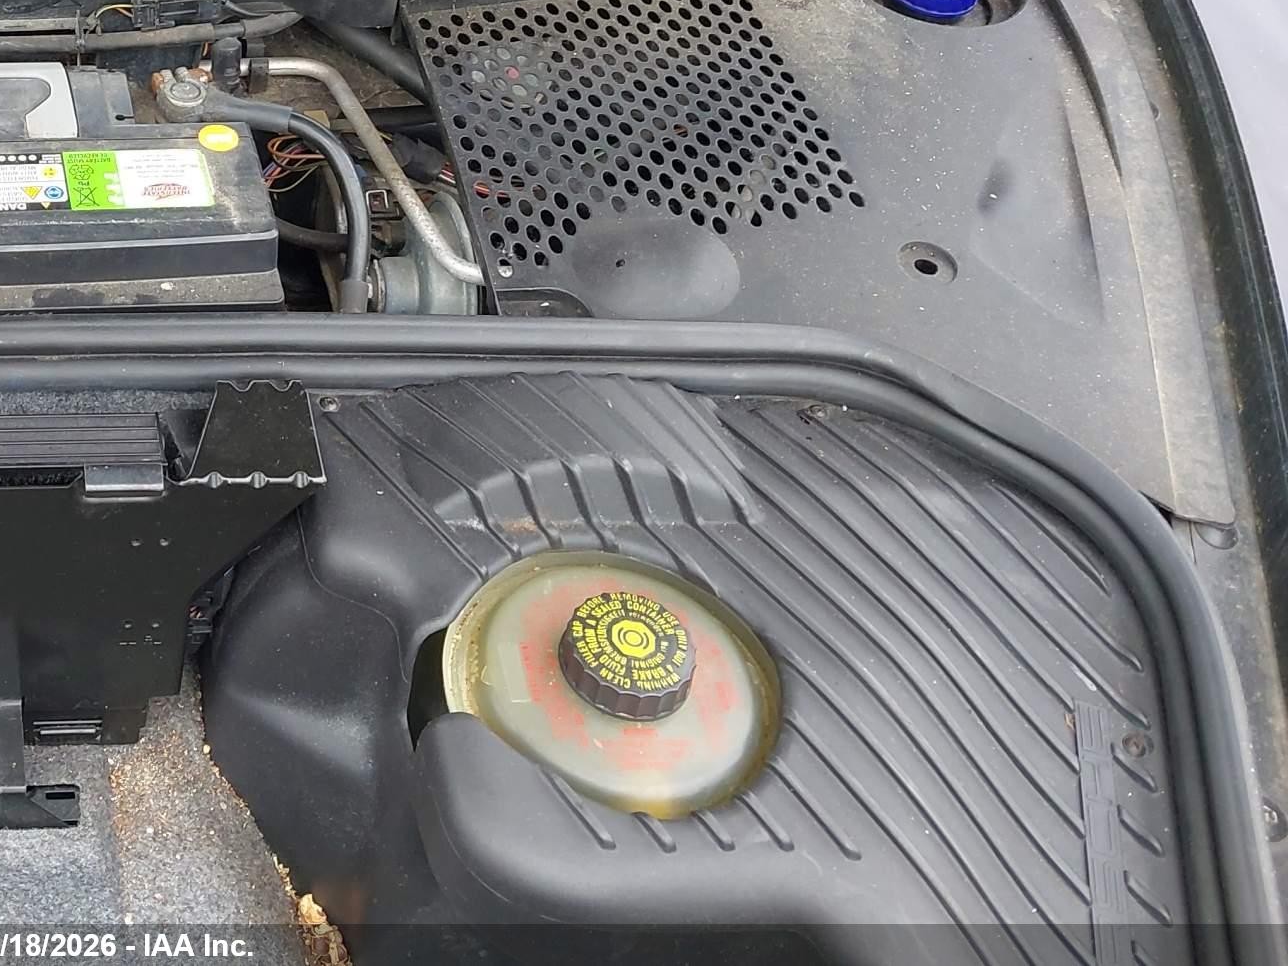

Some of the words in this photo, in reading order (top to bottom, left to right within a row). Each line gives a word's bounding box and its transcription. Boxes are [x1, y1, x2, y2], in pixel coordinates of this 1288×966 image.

[577, 596, 605, 618] BEFORE
[591, 600, 622, 618] SEALED
[626, 600, 675, 635] CONTAINER
[572, 620, 583, 637] CAP
[662, 611, 680, 627] USE
[584, 628, 602, 654] FROM
[575, 640, 599, 667] FILLER
[599, 654, 626, 675] FLUID
[631, 666, 666, 681] BRAKE
[599, 668, 631, 689] CLEAN
